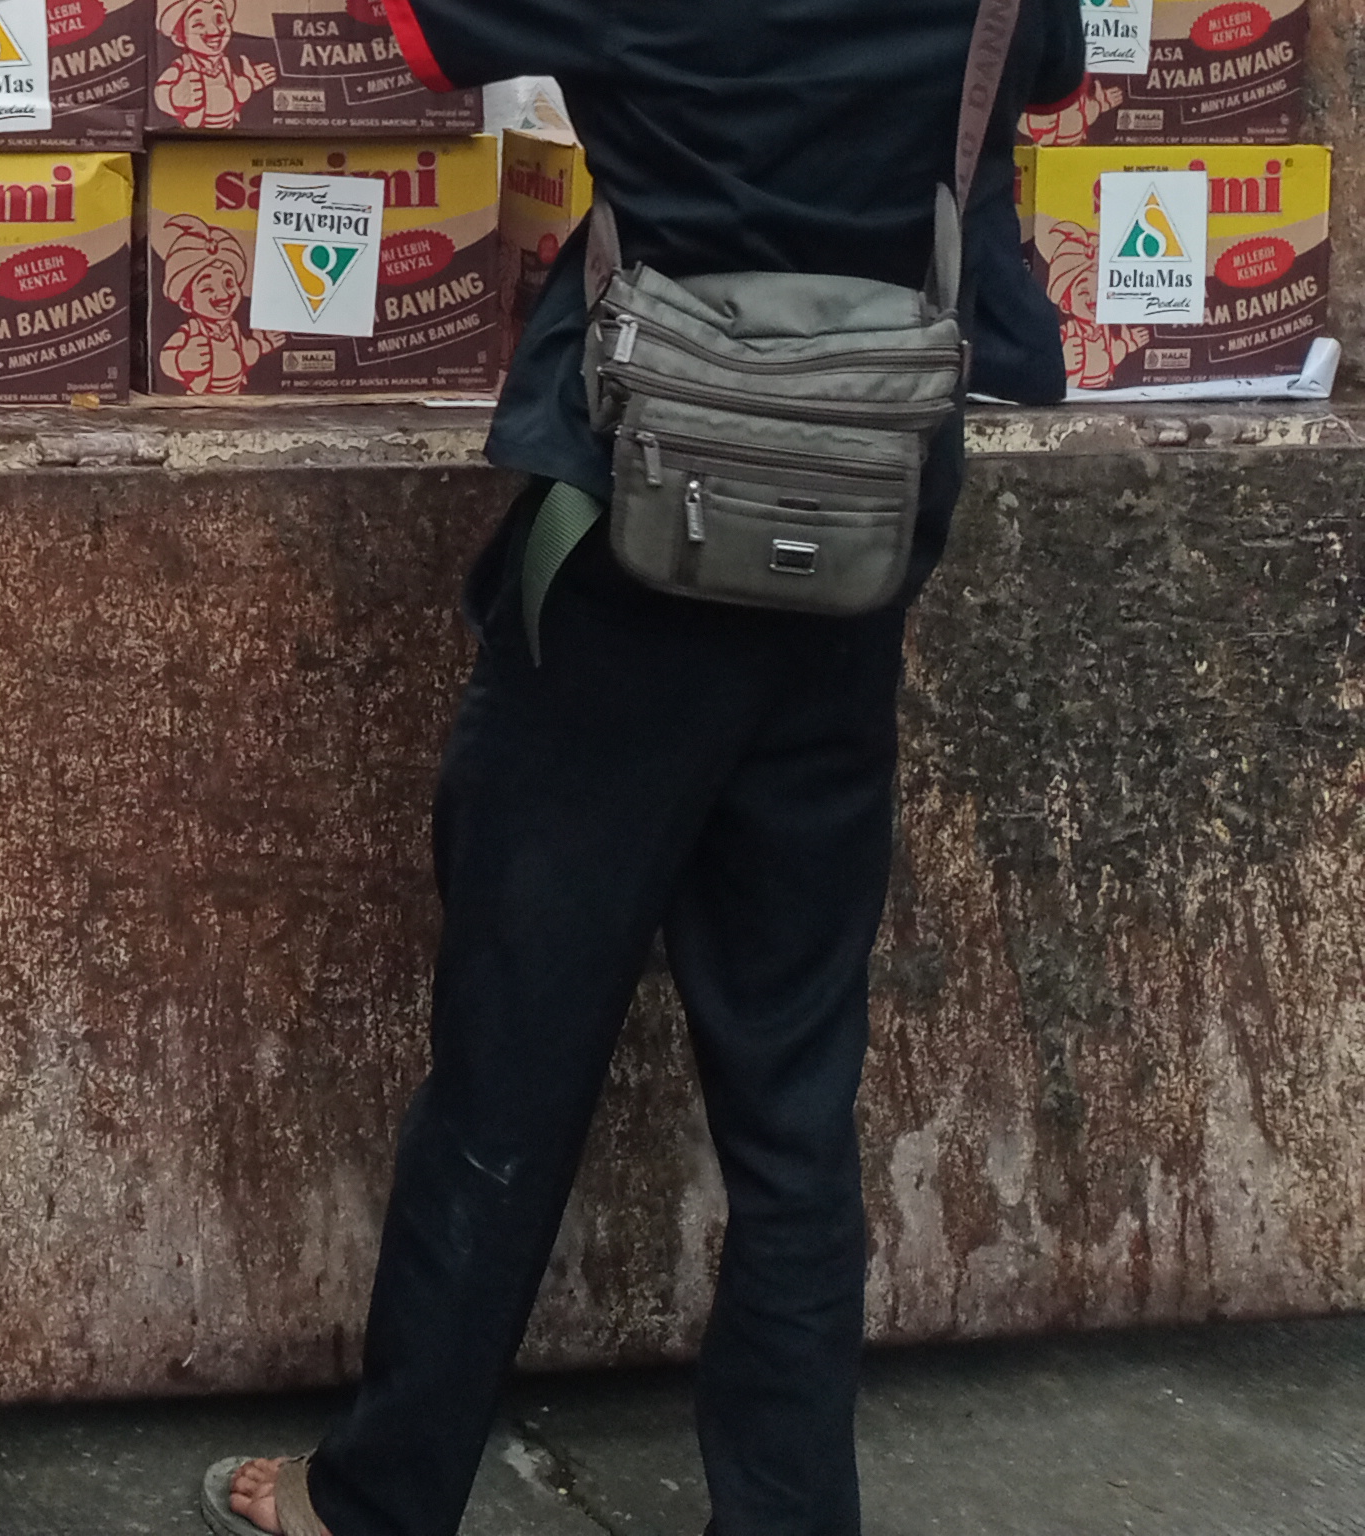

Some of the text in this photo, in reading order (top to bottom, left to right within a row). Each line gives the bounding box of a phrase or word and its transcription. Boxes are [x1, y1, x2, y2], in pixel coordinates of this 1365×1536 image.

[292, 19, 340, 37] RASA
[1084, 18, 1139, 40] taMas
[1212, 27, 1254, 46] KENYAL
[50, 34, 135, 81] AWANG
[299, 41, 368, 68] AYAM
[1090, 45, 1137, 60] Peduli
[1145, 40, 1295, 91] AYAM BAWANG
[75, 76, 130, 104] BAWANG
[1200, 78, 1288, 115] MINYAK BAWANG
[275, 188, 328, 204] Peduli
[272, 210, 370, 238] DeltaMas
[396, 239, 432, 260] LEBIH
[1246, 246, 1276, 265] LEBIH
[30, 253, 66, 274] LEBIH
[385, 255, 434, 277] KENYAL
[1237, 263, 1278, 282] KENYAL
[18, 268, 68, 293] KENYAL
[1108, 268, 1193, 289] DeltaMas
[384, 270, 485, 322] BAWANG
[1145, 296, 1191, 310] Peduli
[1235, 275, 1318, 322] BAWANG
[16, 286, 117, 338] BAWANG
[376, 312, 481, 355] MINYAK BAWANG
[1228, 314, 1314, 353] MINYAK BAWANG
[7, 327, 113, 370] MINYAK BAWANG
